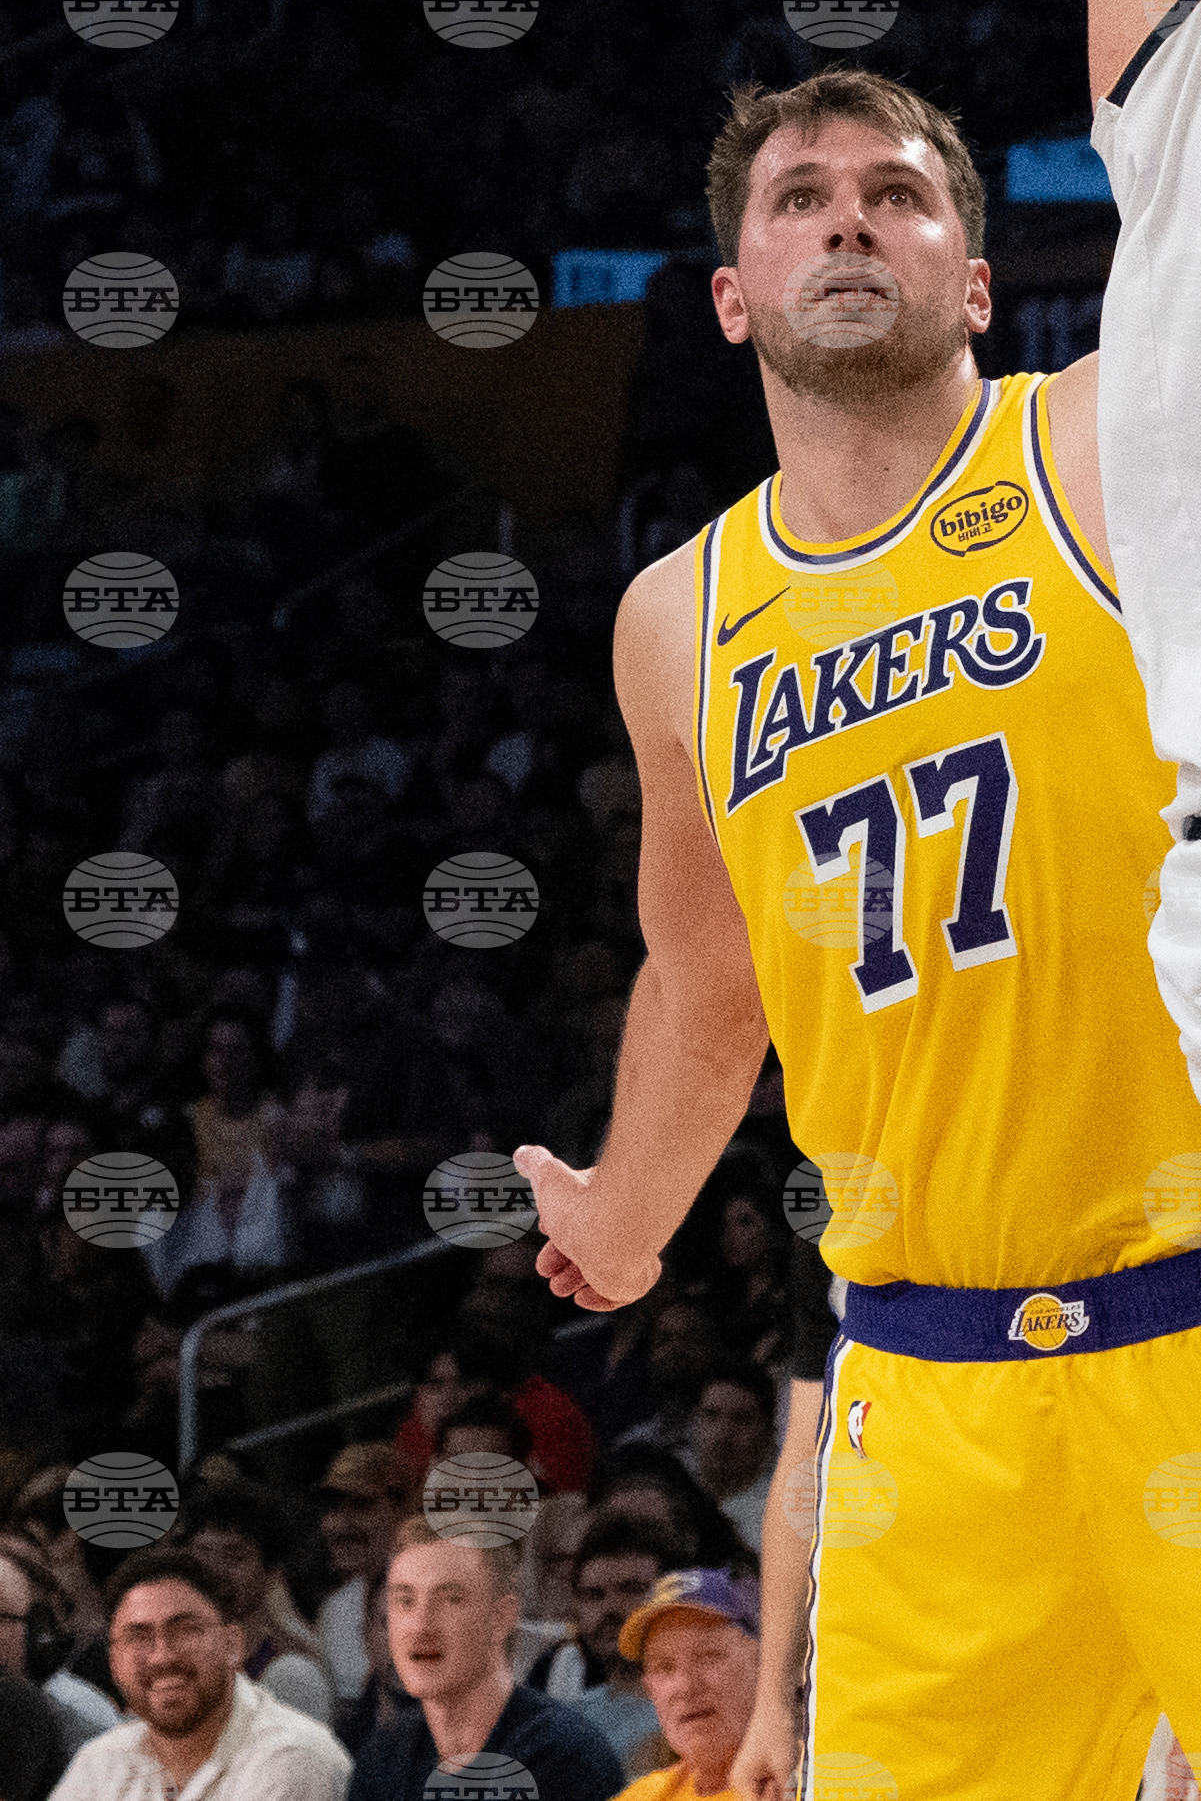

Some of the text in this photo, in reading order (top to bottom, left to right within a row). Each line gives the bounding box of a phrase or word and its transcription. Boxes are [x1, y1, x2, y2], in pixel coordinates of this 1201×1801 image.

[939, 495, 1023, 537] bibigo
[726, 577, 1047, 814] LAKERS
[793, 731, 1020, 1015] 77
[1013, 1310, 1087, 1338] LAKERS
